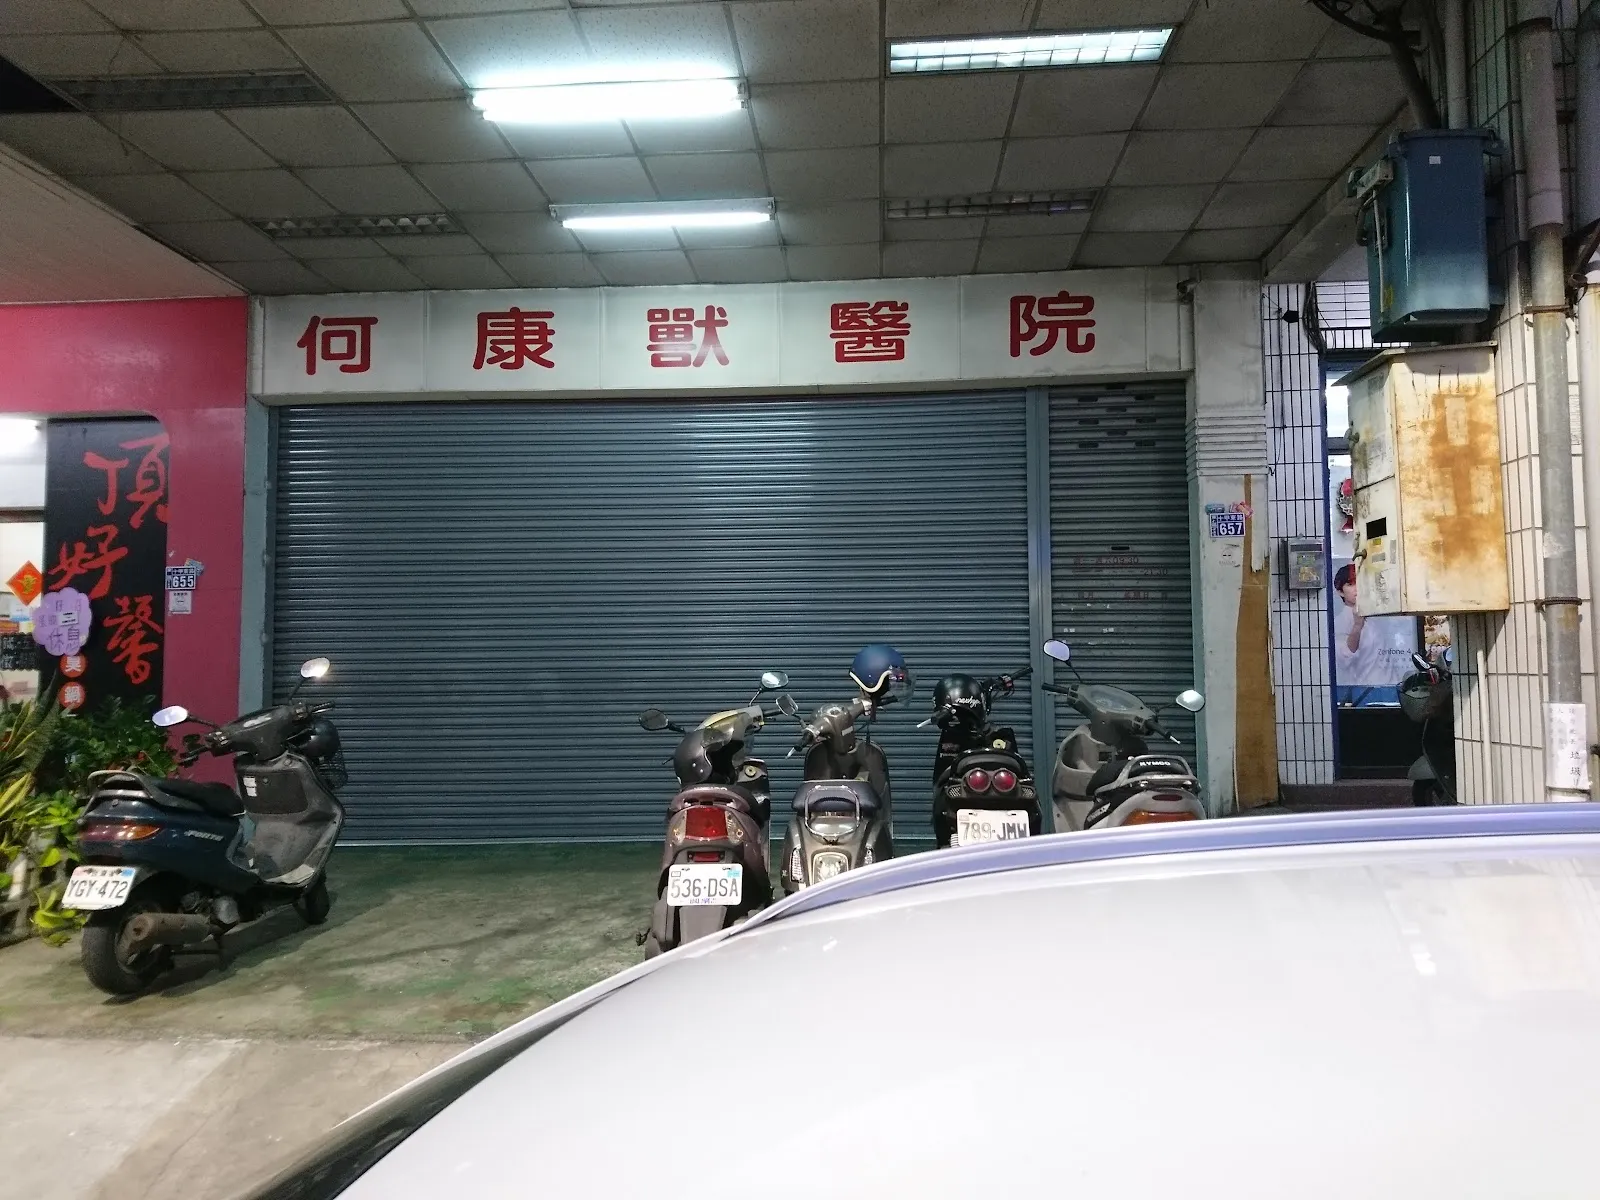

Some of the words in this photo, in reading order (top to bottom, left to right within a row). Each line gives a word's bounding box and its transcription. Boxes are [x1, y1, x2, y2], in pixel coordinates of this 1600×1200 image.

[296, 290, 1096, 376] 何康獸醫院
[1220, 523, 1242, 535] 657
[172, 576, 194, 588] 655
